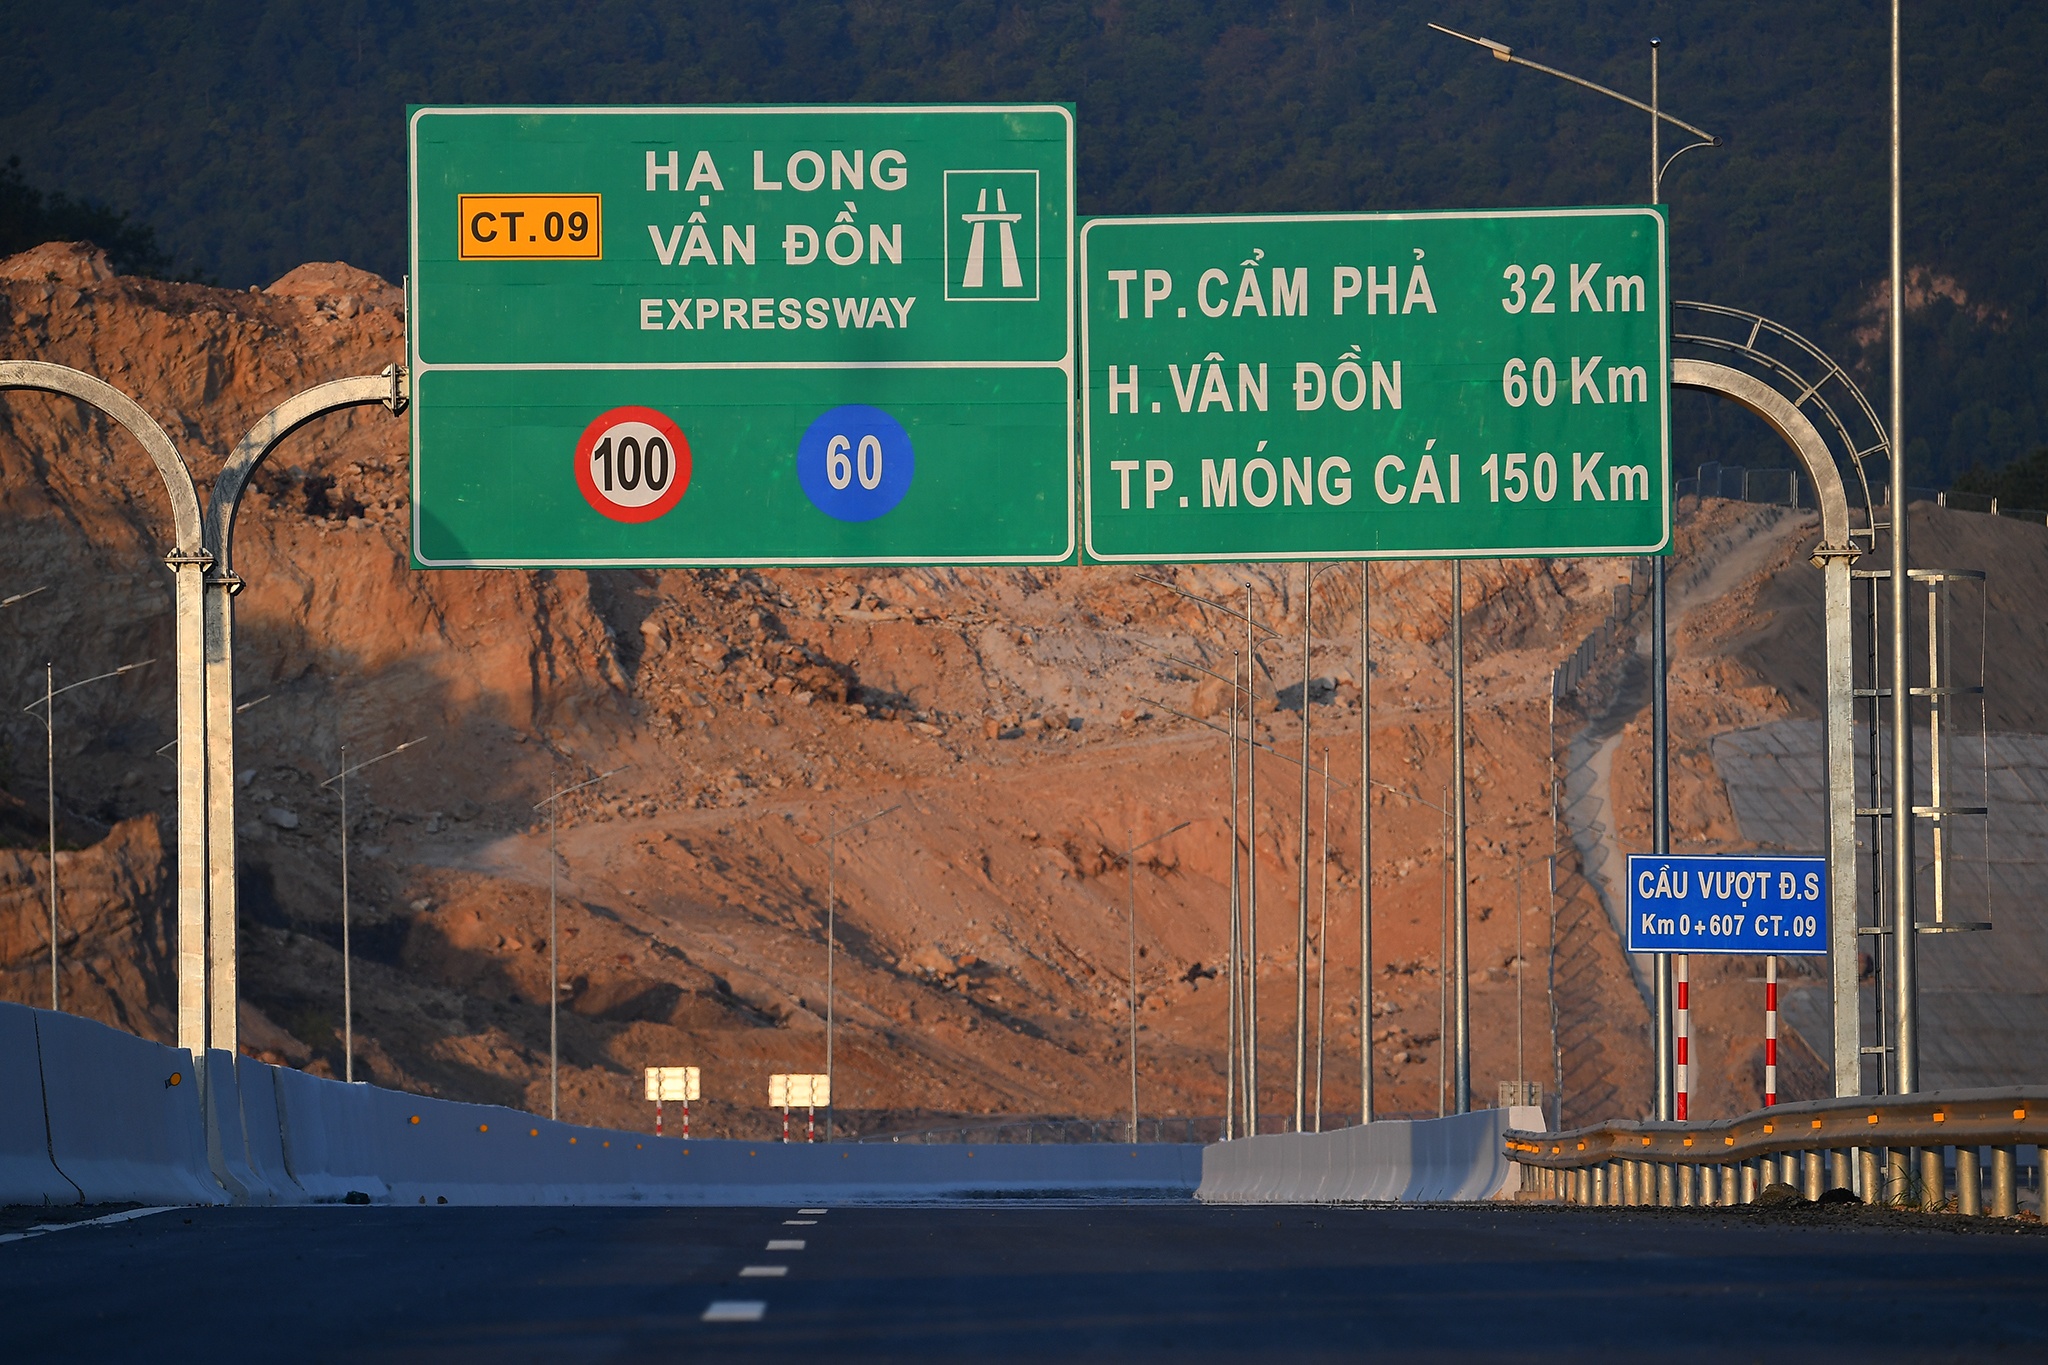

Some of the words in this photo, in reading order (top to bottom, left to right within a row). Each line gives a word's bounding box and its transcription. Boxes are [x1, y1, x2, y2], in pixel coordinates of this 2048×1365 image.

[645, 150, 724, 206] HẠ
[753, 149, 909, 191] LONG
[470, 211, 589, 243] CT.09
[647, 211, 756, 266] VÂN
[782, 202, 902, 266] ĐỒN
[1333, 248, 1437, 315] PHẢ
[1501, 264, 1556, 314] 32
[1569, 263, 1645, 313] Km
[640, 297, 916, 330] EXPRESSWAY
[1293, 344, 1402, 411] ĐỒN
[1502, 358, 1556, 407] 60
[1571, 356, 1648, 405] Km
[593, 436, 668, 492] 100
[825, 434, 882, 490] 60
[1375, 439, 1459, 504] CÁI
[1481, 452, 1557, 502] 150
[1572, 452, 1649, 501] Km
[1638, 864, 1688, 899] CẦU
[1698, 871, 1771, 907] VƯỢT
[1779, 872, 1819, 900] Đ.S
[1754, 915, 1816, 937] CT.09
